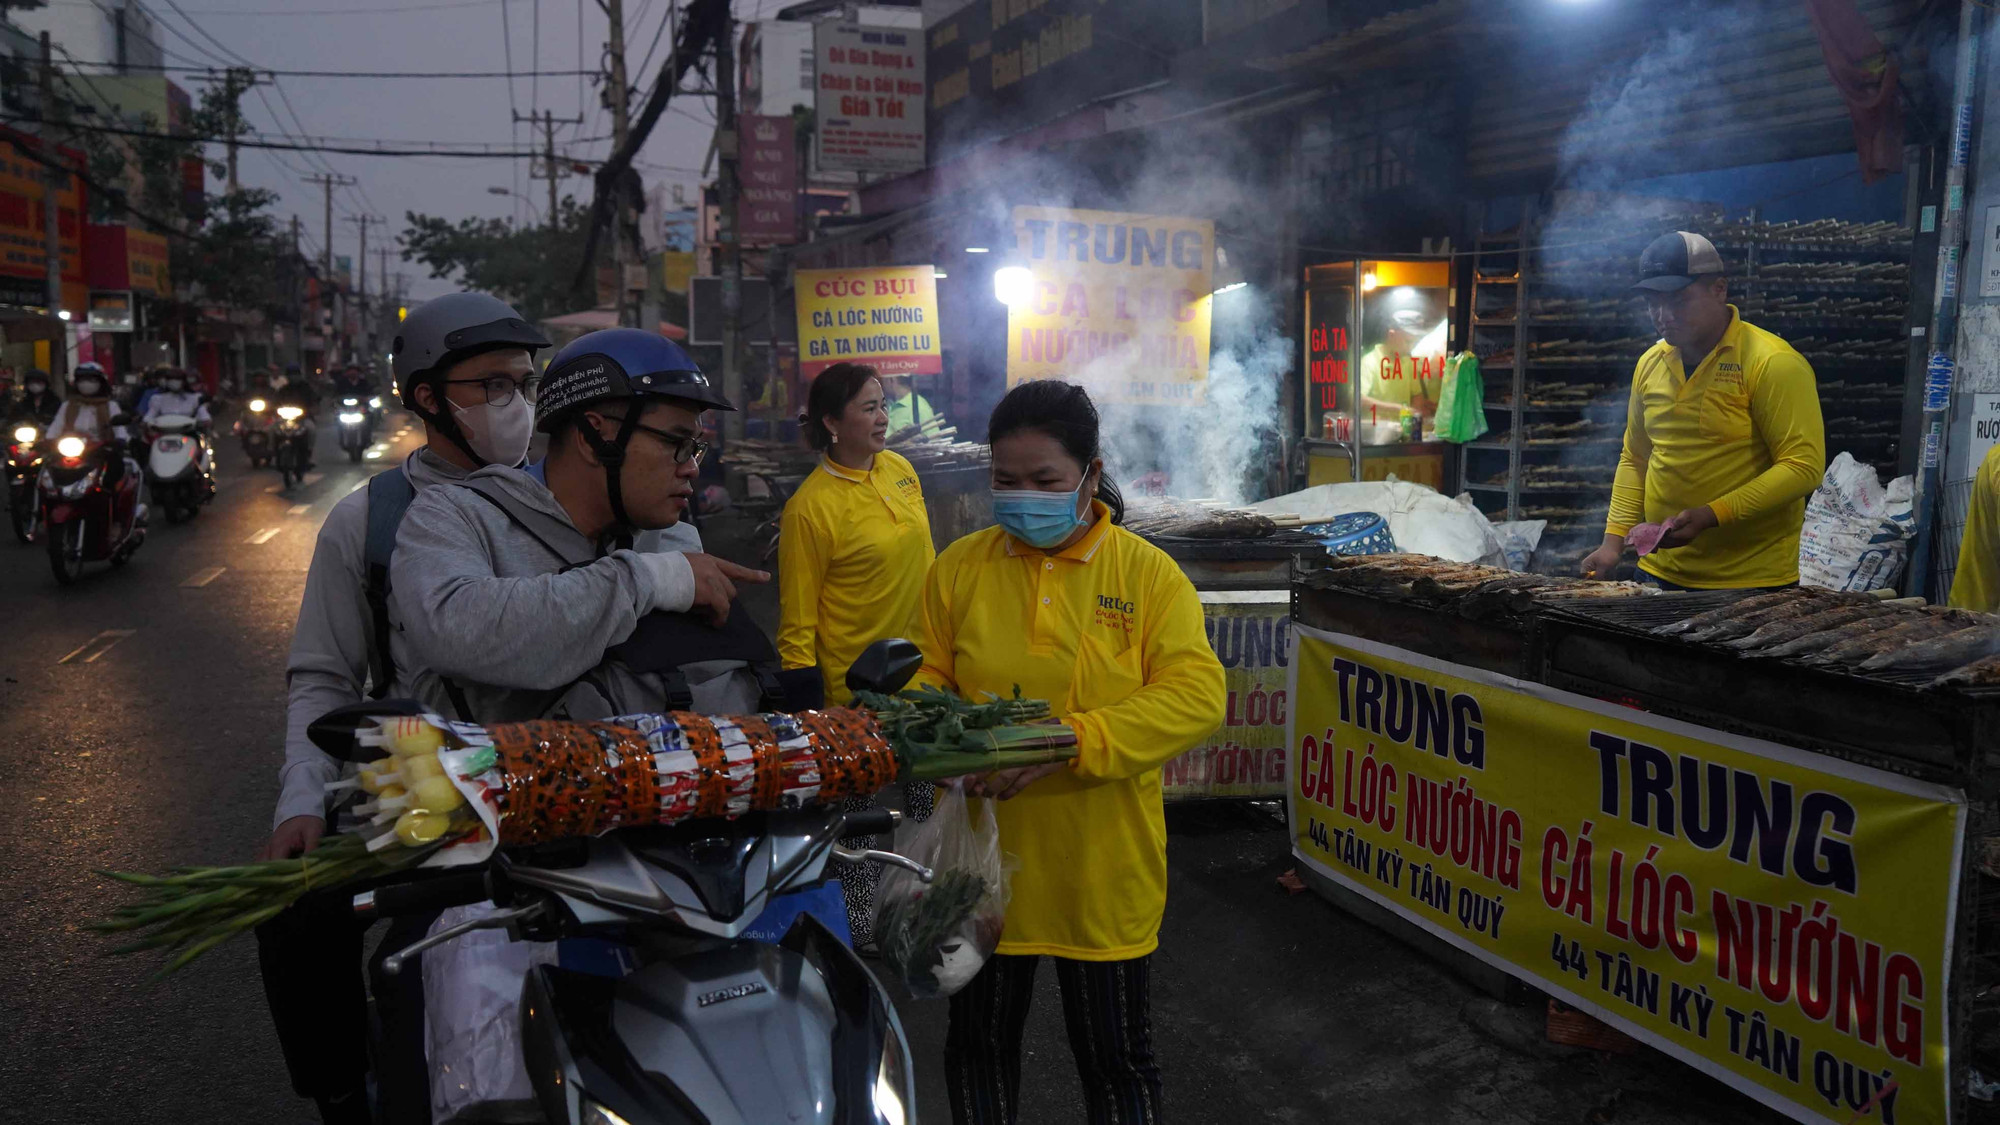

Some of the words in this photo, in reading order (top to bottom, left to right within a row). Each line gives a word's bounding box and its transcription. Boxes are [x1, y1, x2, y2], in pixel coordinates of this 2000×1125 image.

[841, 95, 870, 116] Giá
[875, 95, 904, 118] Tốt
[1025, 219, 1204, 269] TRUNG
[815, 276, 866, 298] CÚC
[874, 278, 917, 299] BỤI
[813, 307, 833, 328] CÁ
[838, 306, 866, 326] LÓC
[872, 305, 923, 324] NƯỚNG
[809, 337, 831, 357] GÀ
[834, 338, 852, 354] TA
[856, 333, 908, 353] NƯỚNG
[913, 335, 930, 350] LU
[1311, 323, 1328, 351] GÀ
[1332, 328, 1347, 350] TA
[1380, 352, 1403, 380] GÀ
[1410, 357, 1431, 379] TA
[1719, 363, 1741, 371] TRUN
[1321, 386, 1336, 409] LU
[896, 477, 916, 489] TRUG
[1097, 595, 1134, 614] TRUG
[1206, 615, 1290, 668] UNG
[1226, 683, 1286, 726] LÓC
[1333, 658, 1484, 769] TRUNG
[1164, 742, 1286, 786] NƯỚNG
[1301, 729, 1334, 808] CÁ
[1343, 743, 1397, 833] LÓC
[1405, 773, 1521, 890] NƯỚNG
[1590, 730, 1857, 894] TRUNG
[1309, 818, 1330, 853] 44
[1333, 828, 1371, 874] TÂN
[1376, 848, 1404, 888] KỲ
[1409, 863, 1451, 914] TÂN
[1458, 887, 1505, 939] QUÝ
[1541, 821, 1593, 925] CÁ
[1606, 846, 1698, 963] LÓC
[1713, 890, 1923, 1067] NƯỚNG
[698, 981, 767, 1007] HONDA
[1551, 933, 1588, 980] 44
[1595, 950, 1659, 1015] TÂN
[1669, 983, 1714, 1039] KỲ
[1725, 1007, 1800, 1083] TÂN
[1813, 1051, 1899, 1125] QUÝ
